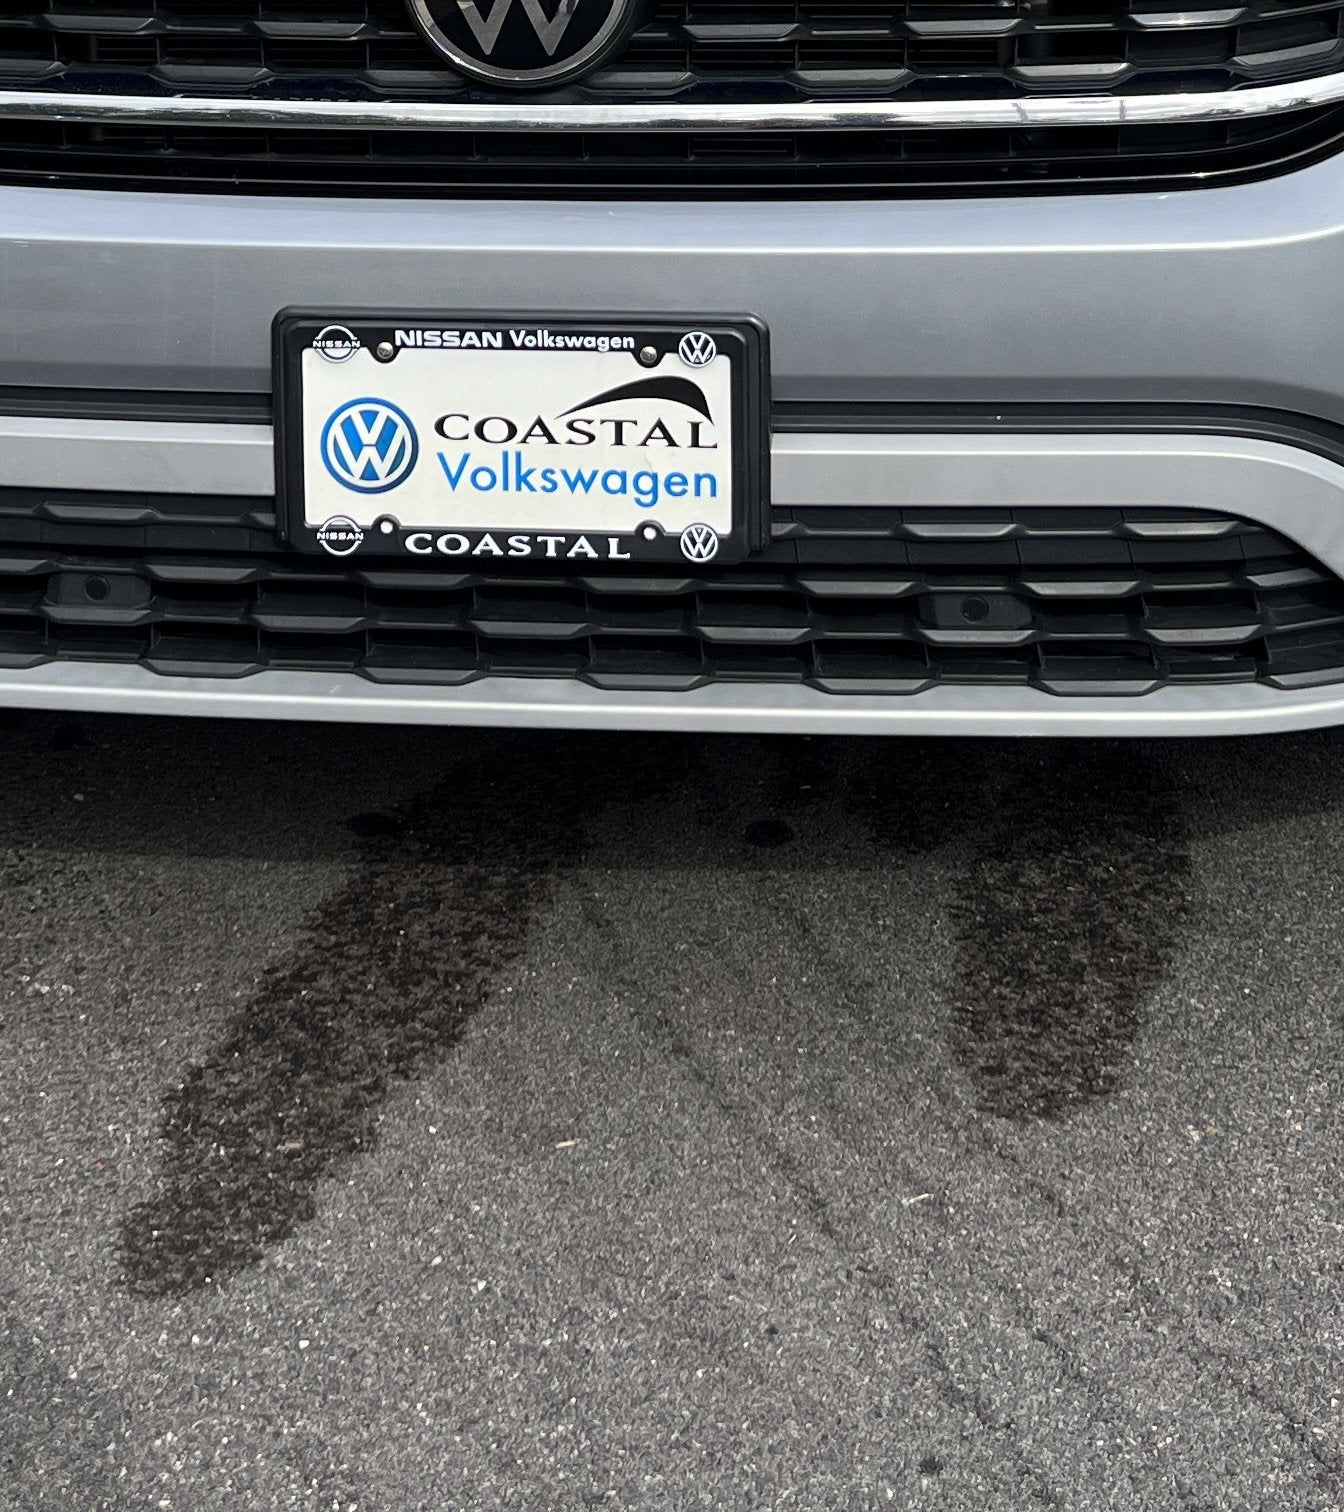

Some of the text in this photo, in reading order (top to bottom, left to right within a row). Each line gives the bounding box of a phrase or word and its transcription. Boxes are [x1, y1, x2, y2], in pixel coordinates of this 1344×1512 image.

[313, 340, 360, 348] NISSAN
[395, 330, 634, 351] NISSAN Volkswagen
[434, 414, 718, 449] COASTAL
[437, 451, 717, 508] Volkswagen
[317, 531, 364, 540] NISSAN
[405, 533, 631, 559] COASTAL
